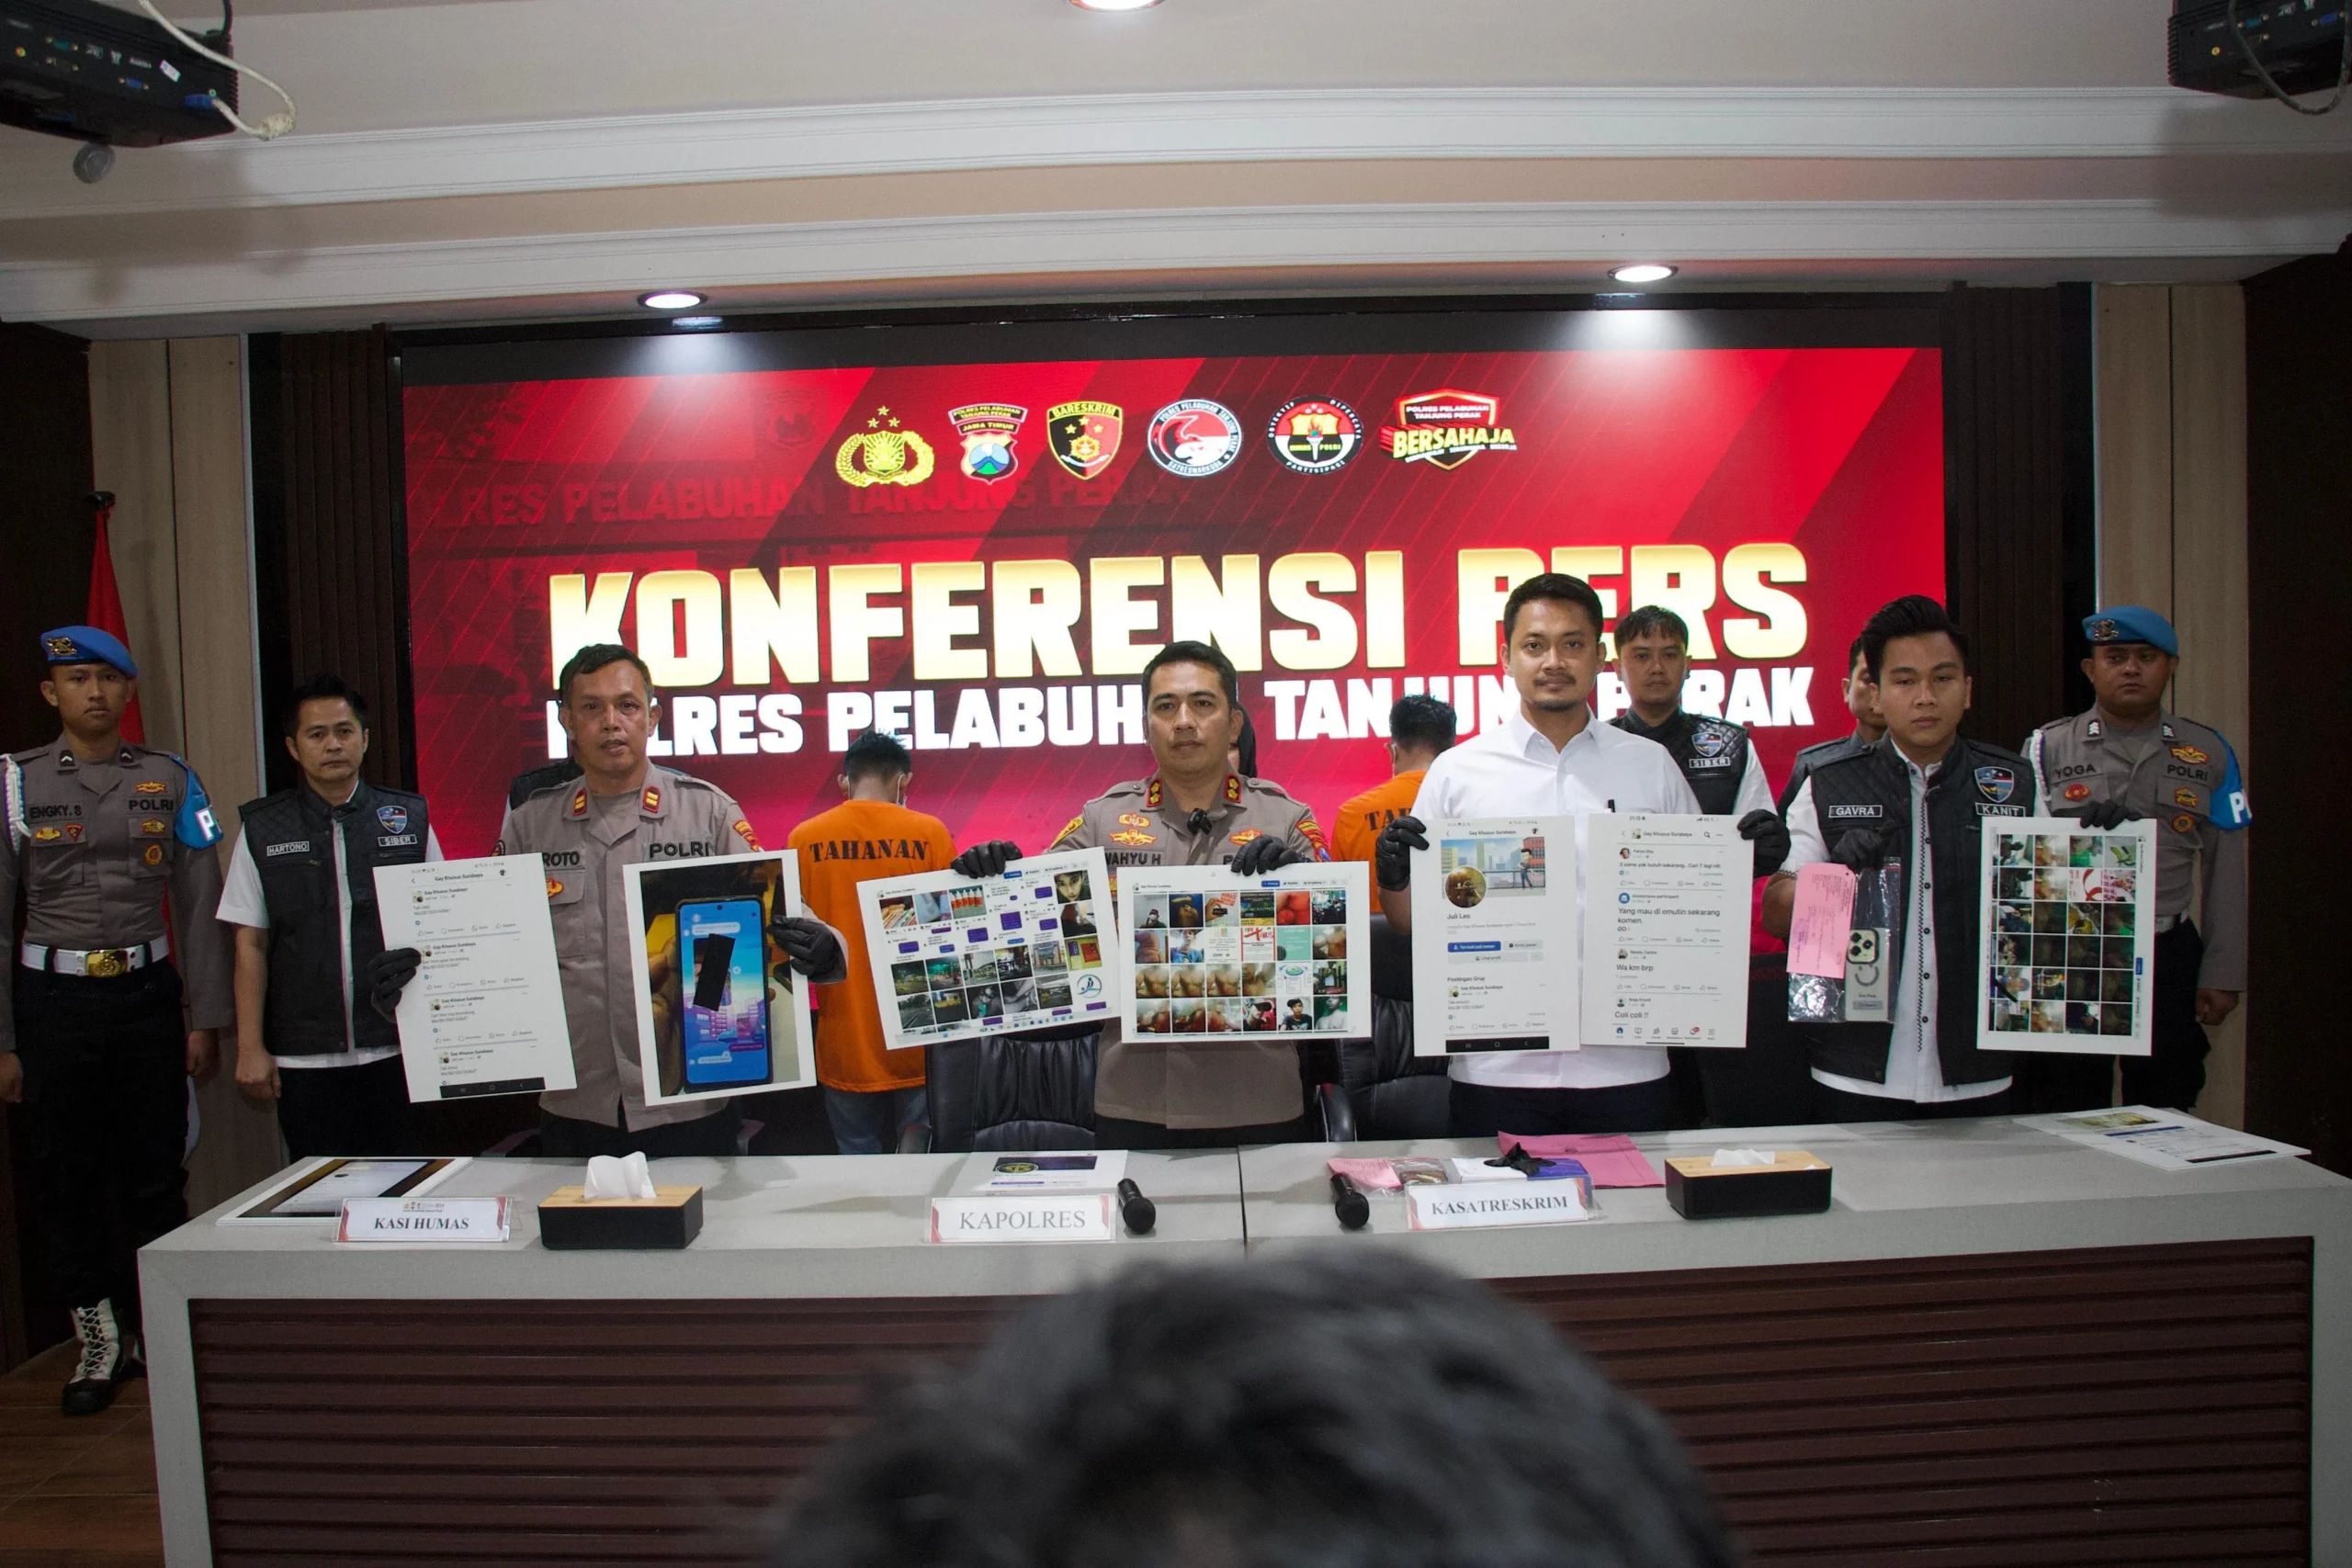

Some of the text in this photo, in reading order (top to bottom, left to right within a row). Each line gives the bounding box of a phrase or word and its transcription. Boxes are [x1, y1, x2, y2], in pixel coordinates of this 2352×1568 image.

[1052, 402, 1116, 418] BARESKRIM
[962, 422, 1014, 432] JAWA TIMUR
[1393, 426, 1516, 459] BERSAHAJA
[1285, 460, 1346, 474] PARTISIPASI
[548, 549, 1406, 691] KONFERENSI
[827, 682, 1149, 752] PELABUH
[1596, 667, 1815, 728] PRAK
[1693, 758, 1727, 768] SIBER
[2054, 763, 2097, 779] YOGA
[2166, 763, 2209, 782] POLRI
[129, 798, 175, 812] POLRI
[1836, 807, 1875, 817] GAVRA
[1980, 805, 2019, 817] KANIT
[384, 836, 412, 846] SIBER
[269, 843, 308, 855] HARTONO
[649, 840, 710, 859] POLRI
[809, 838, 930, 863] TAHANAN
[1151, 852, 1162, 865] H
[1618, 907, 1635, 915] Yang
[1661, 908, 1687, 916] emutin
[1687, 908, 1721, 918] sekarang
[1641, 964, 1654, 973] brp
[1614, 1010, 1629, 1019] Coli
[1430, 1195, 1569, 1216] KASATRESKRIM
[373, 1216, 470, 1230] KASI HUMAS
[959, 1210, 1086, 1231] KAPOLRES
